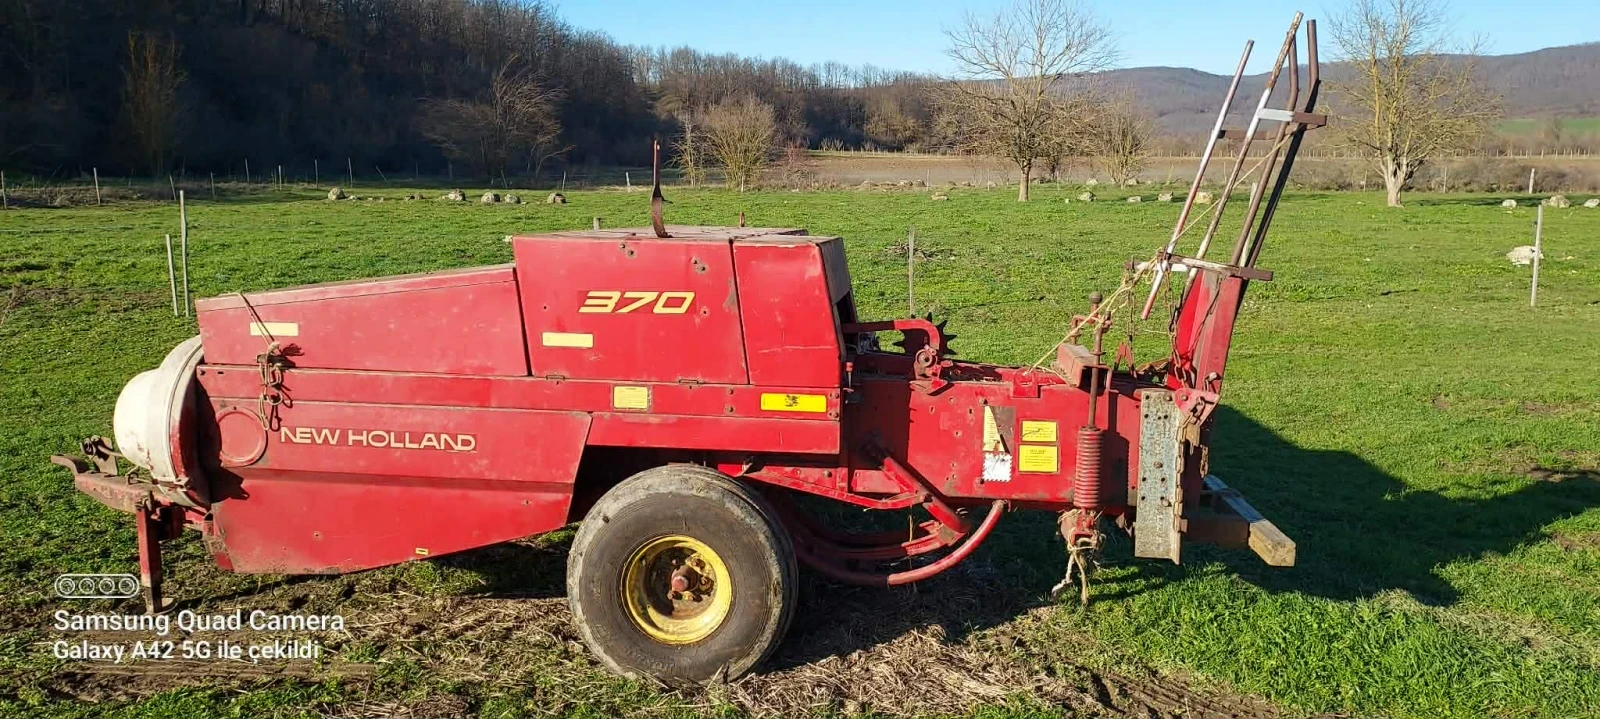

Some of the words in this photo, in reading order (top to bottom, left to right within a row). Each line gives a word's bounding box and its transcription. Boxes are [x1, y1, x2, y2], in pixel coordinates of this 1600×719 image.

[578, 291, 695, 313] 370
[280, 427, 340, 445] NEW
[348, 430, 475, 451] HOLLAND
